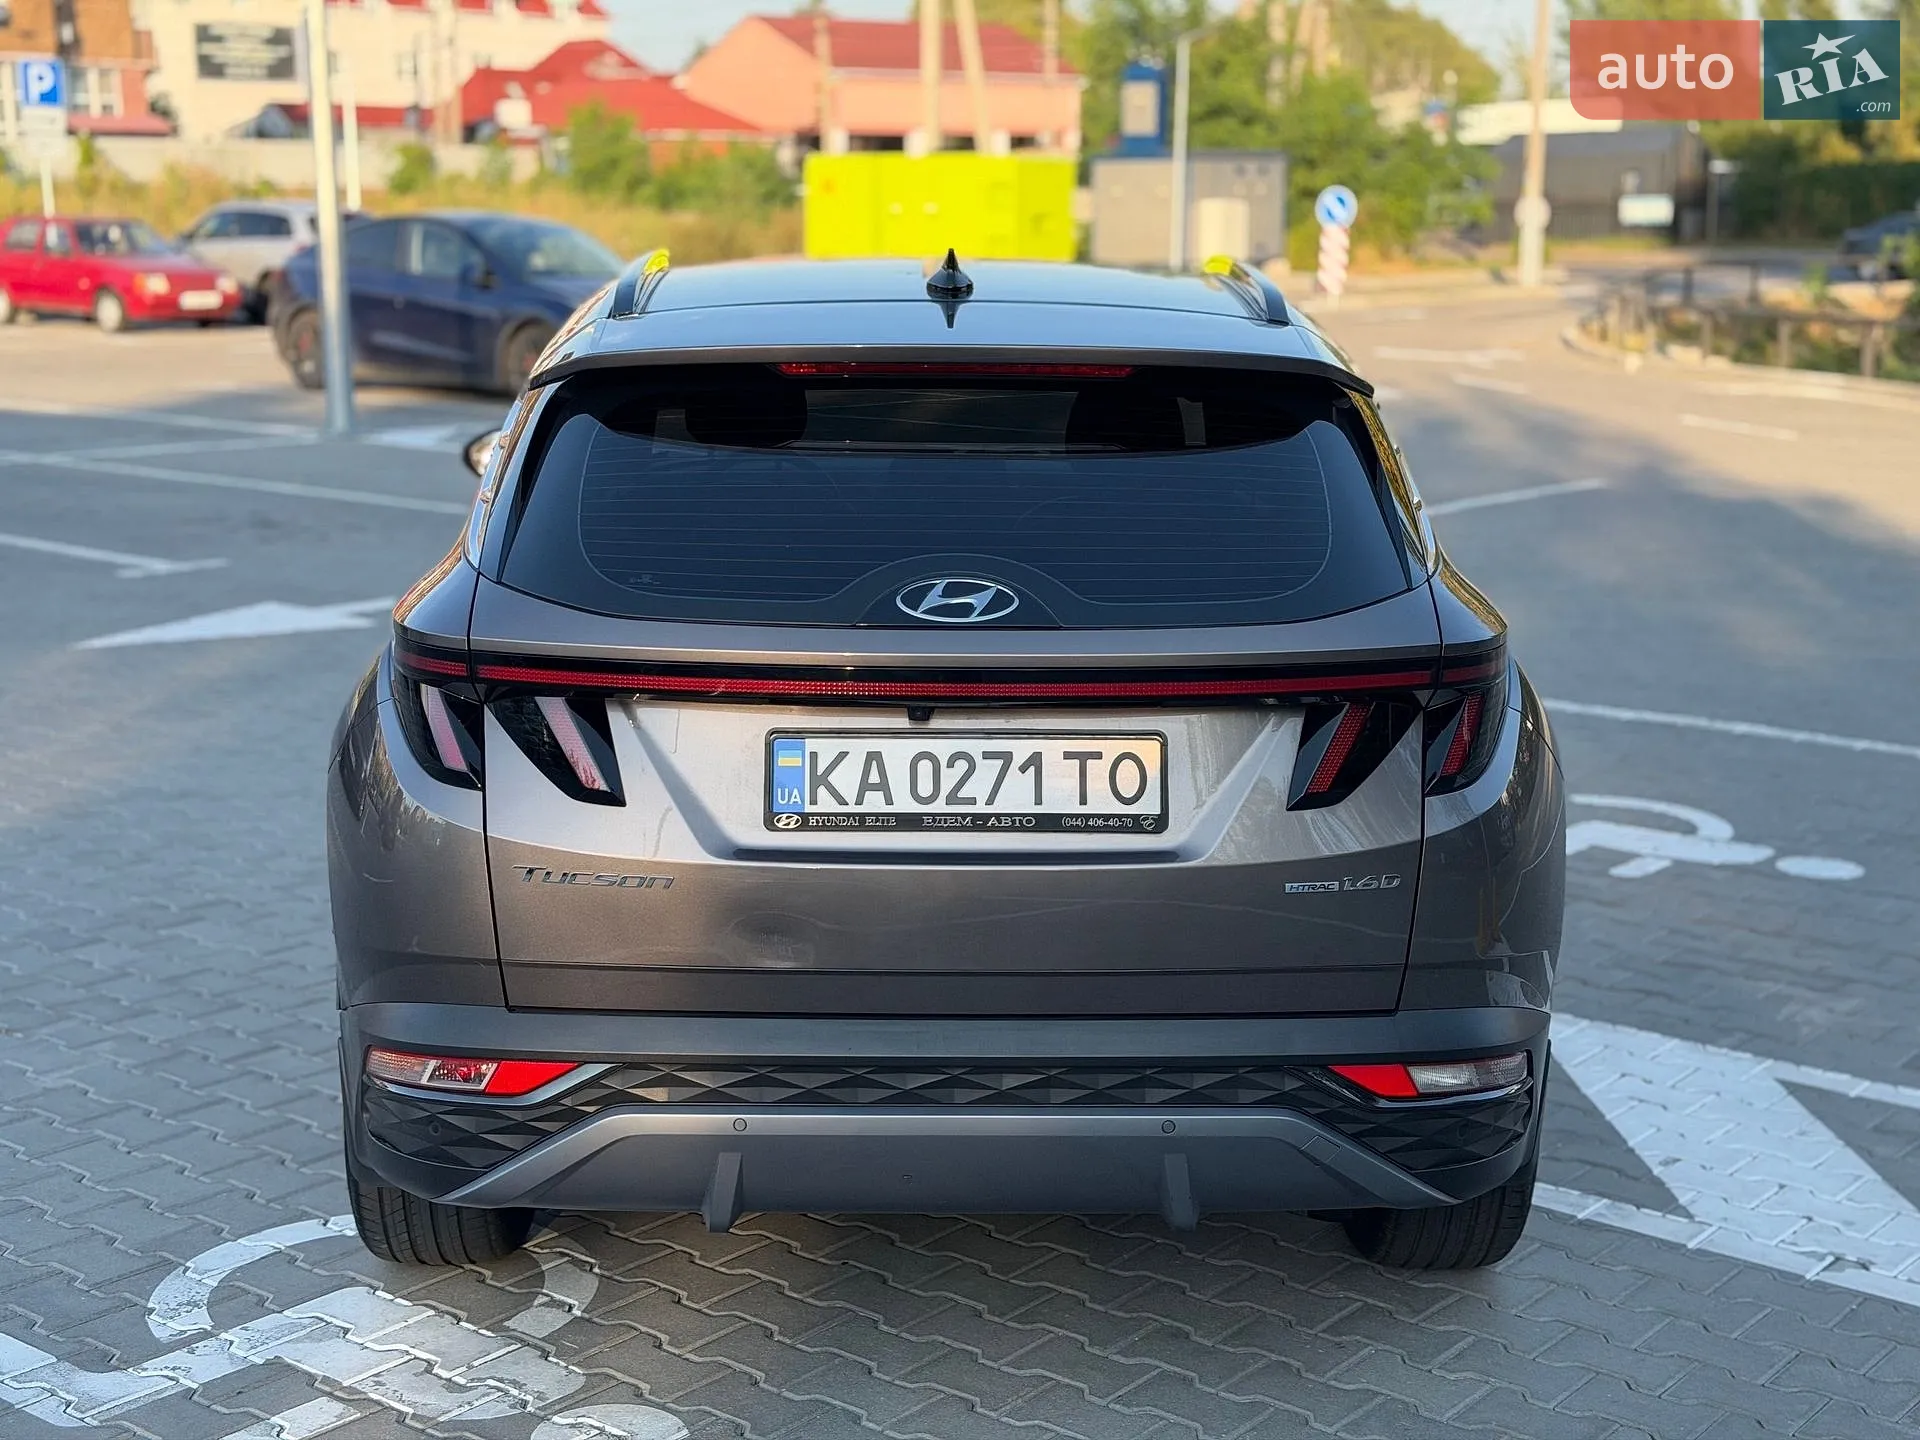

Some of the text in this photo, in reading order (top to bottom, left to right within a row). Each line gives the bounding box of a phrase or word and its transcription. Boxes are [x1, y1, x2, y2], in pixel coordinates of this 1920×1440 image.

[26, 61, 56, 104] P
[809, 751, 1148, 806] KA 0271 TO
[777, 787, 802, 805] UA
[808, 816, 897, 826] HYUNDAI ELITE
[1061, 816, 1133, 828] (044) 406-40-70
[1287, 882, 1338, 893] HTRAC
